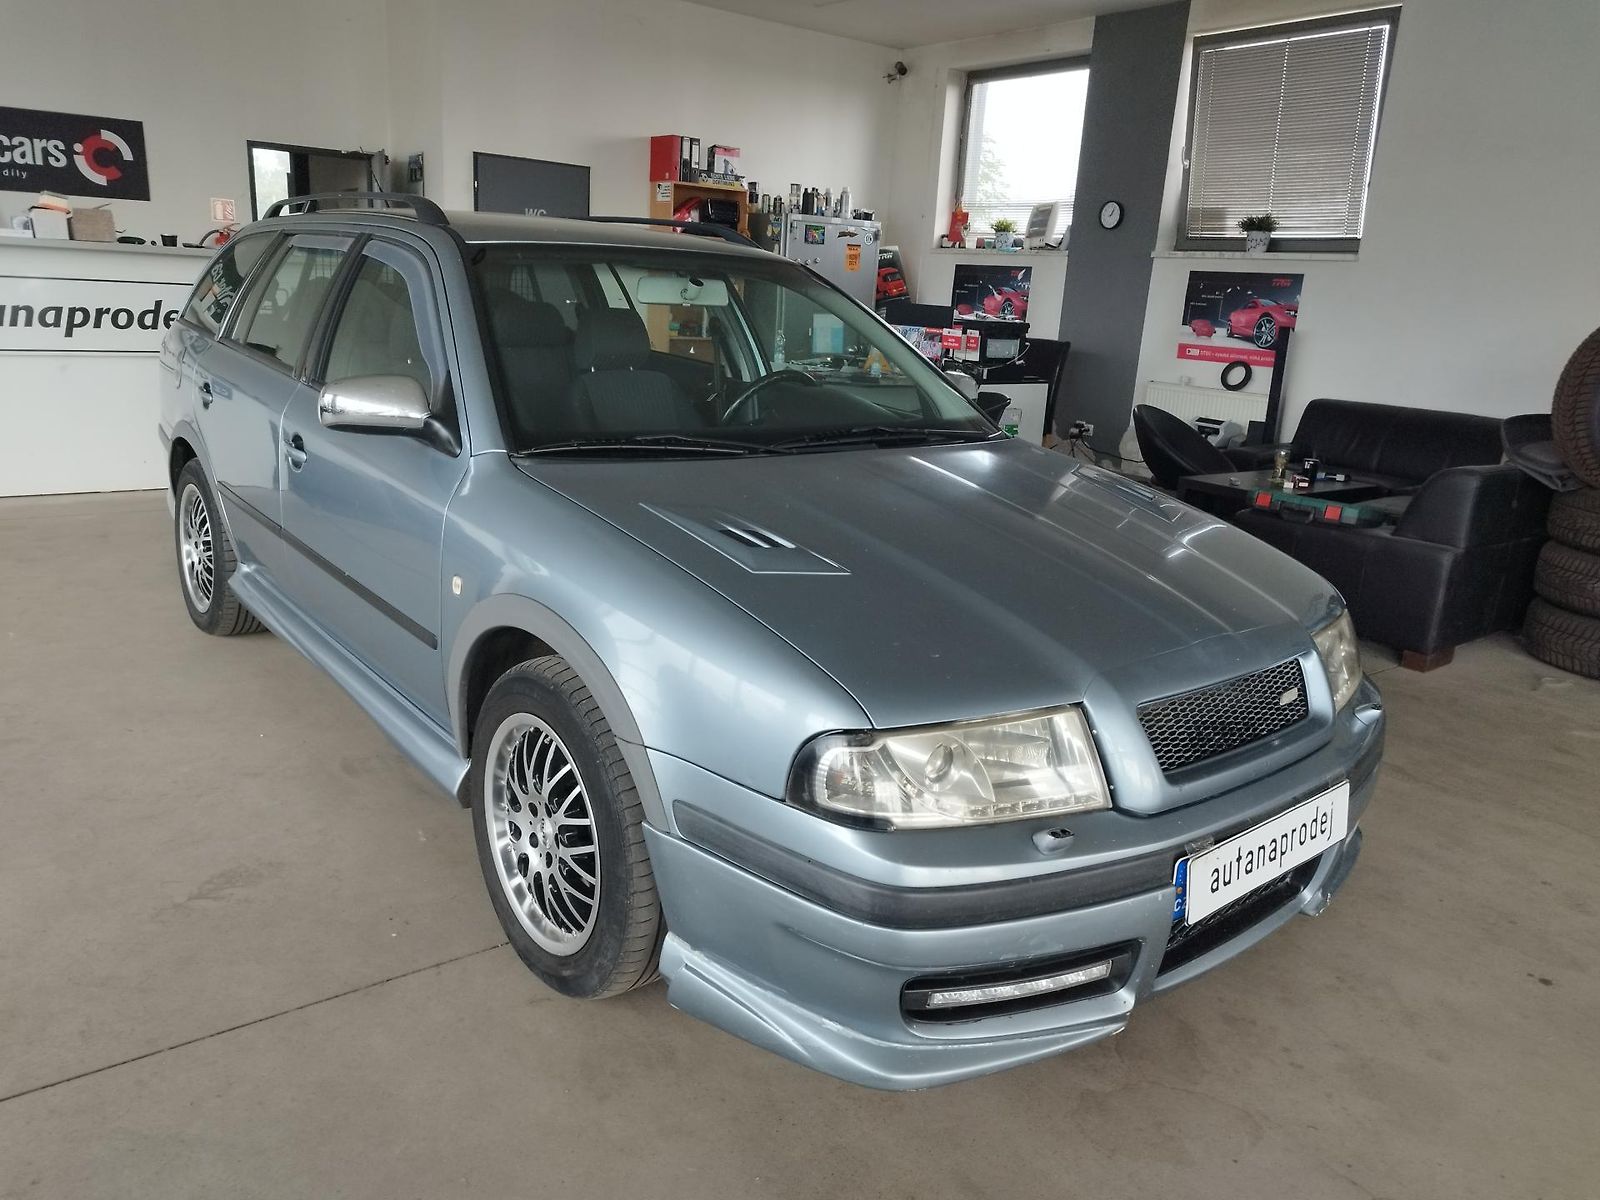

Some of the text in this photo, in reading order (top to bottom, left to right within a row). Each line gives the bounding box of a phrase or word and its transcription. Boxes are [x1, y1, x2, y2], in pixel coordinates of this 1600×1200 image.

[0, 134, 67, 168] cars
[0, 299, 179, 337] naprode
[1210, 802, 1334, 894] autanaprodej
